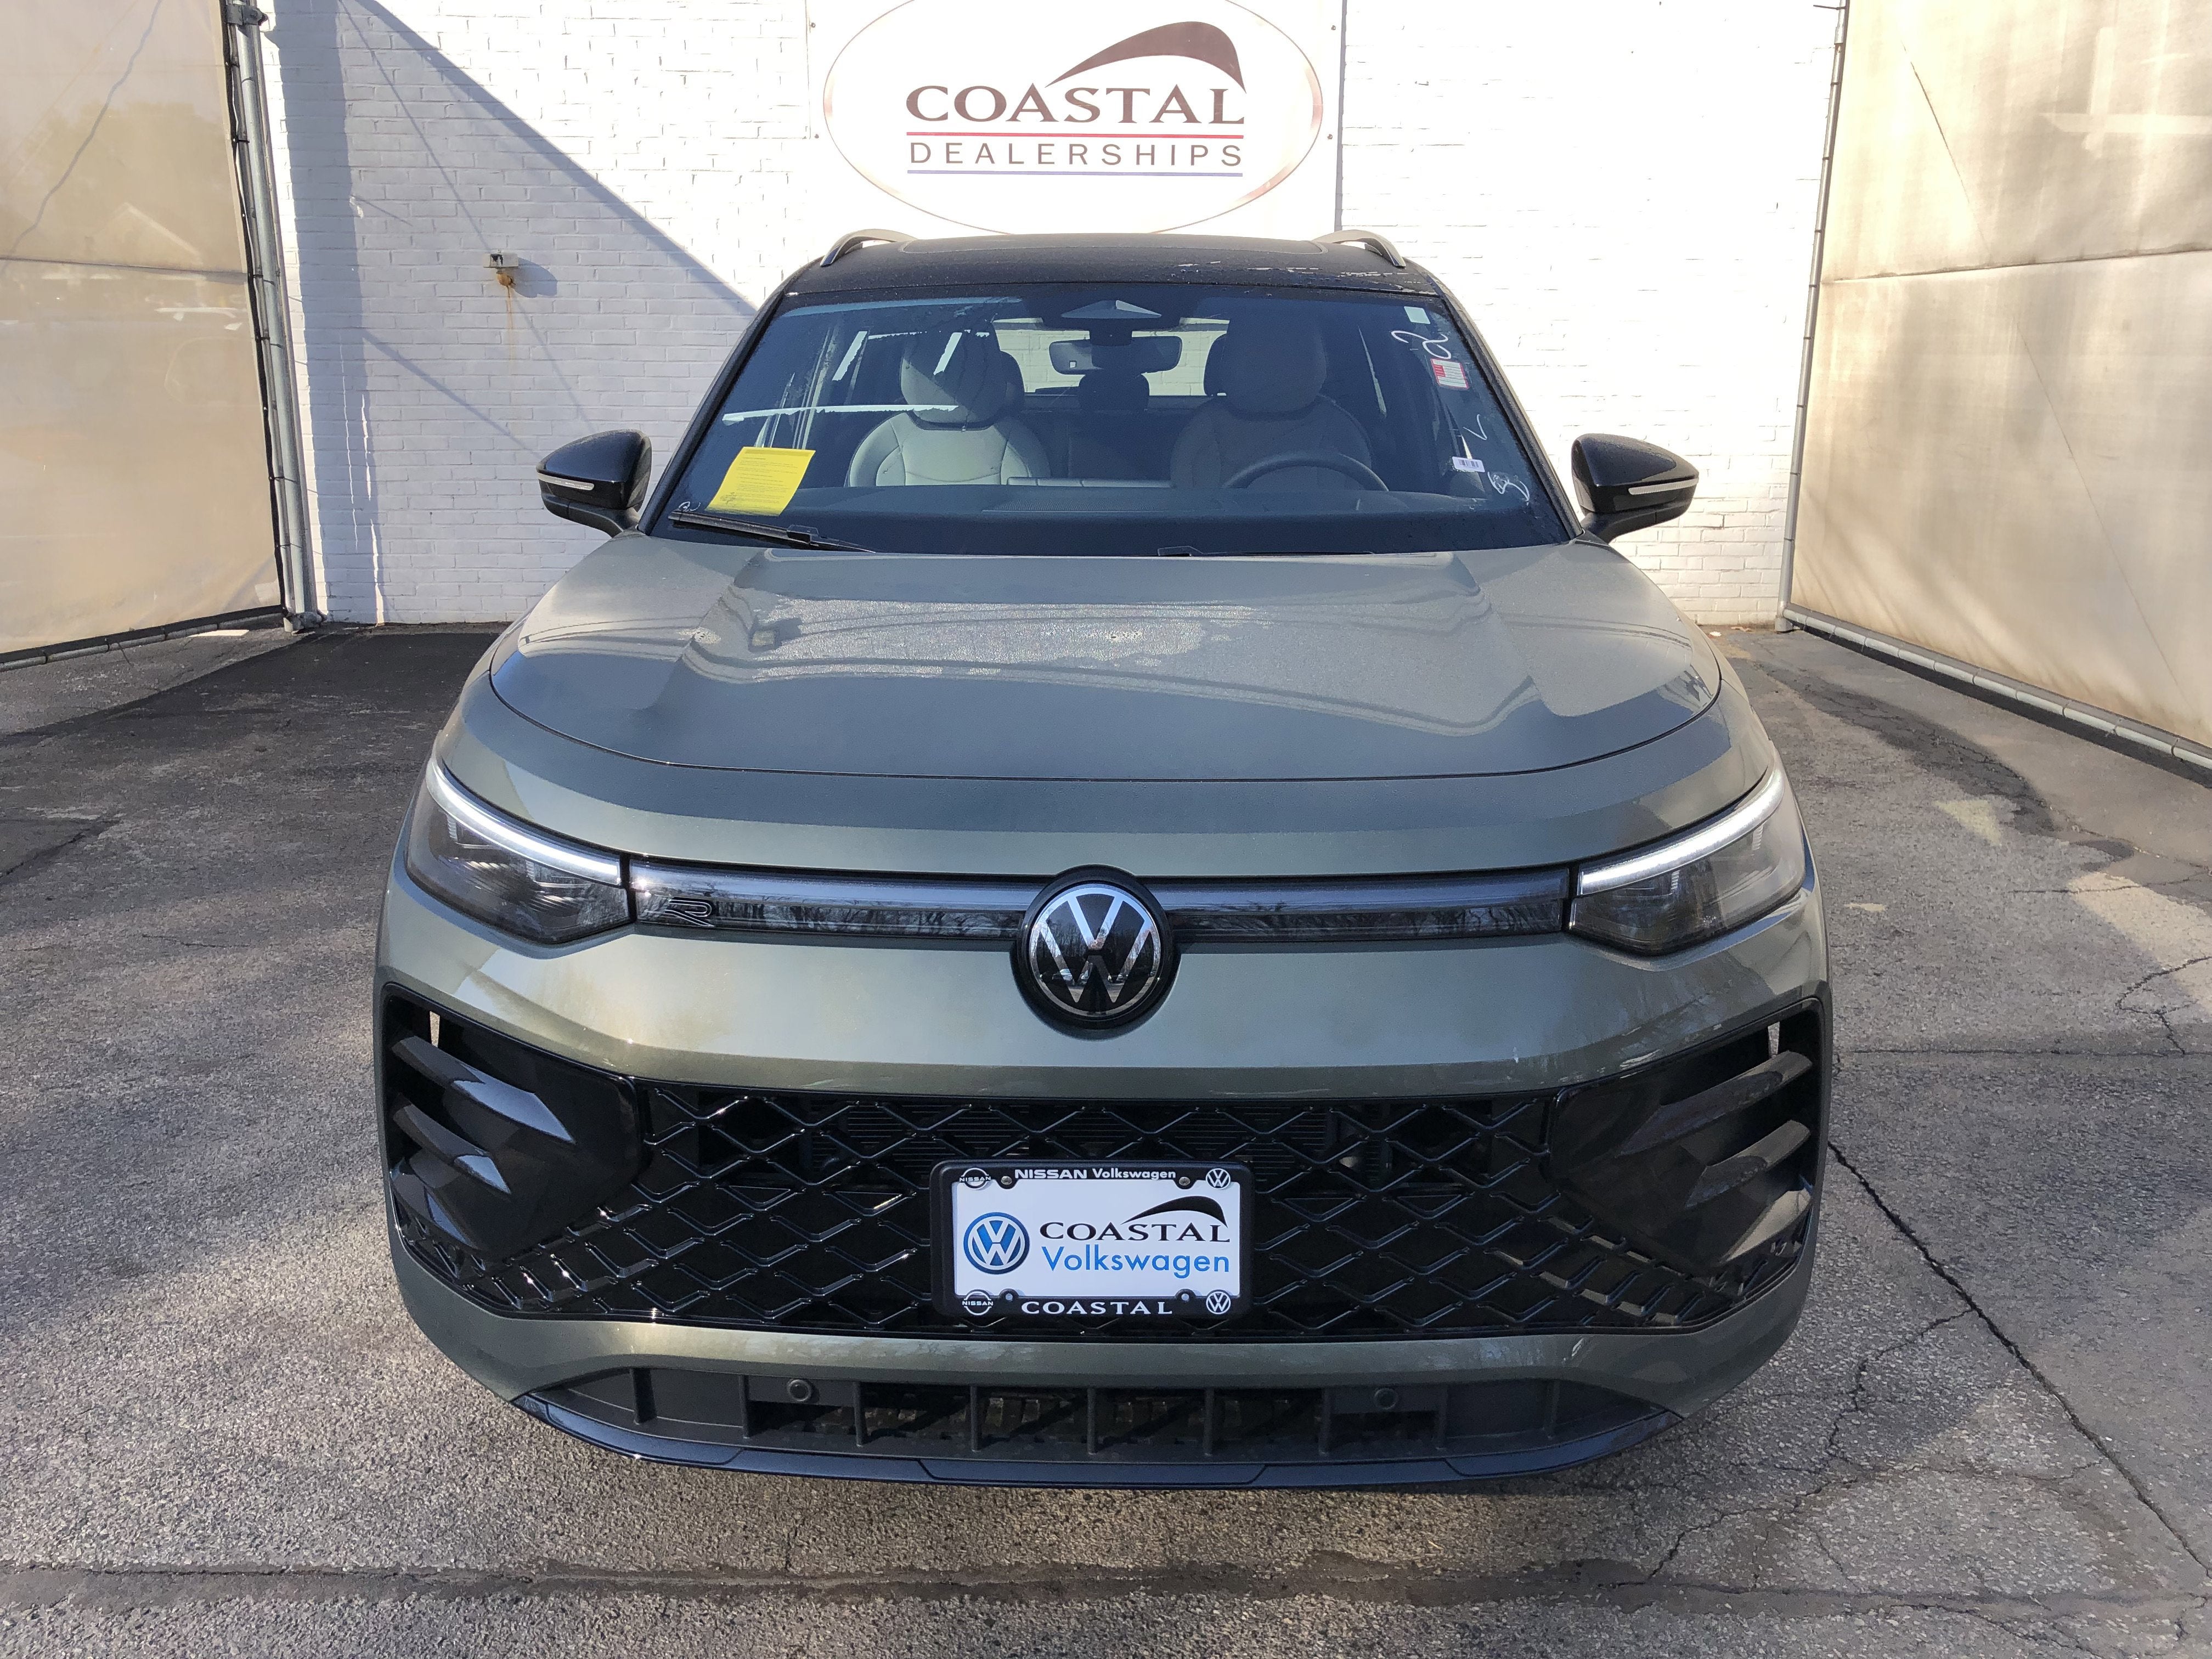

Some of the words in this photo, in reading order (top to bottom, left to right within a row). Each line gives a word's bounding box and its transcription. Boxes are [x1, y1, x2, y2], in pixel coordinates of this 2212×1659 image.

[906, 83, 1245, 125] COASTAL
[911, 142, 1242, 167] DEALERSHIPS
[1015, 1169, 1087, 1179] NISSAN
[1092, 1168, 1176, 1180] Volkswagen
[1040, 1222, 1230, 1243] COASTAL
[1042, 1244, 1229, 1279] Volkswagen
[1021, 1301, 1172, 1315] COASTAL
